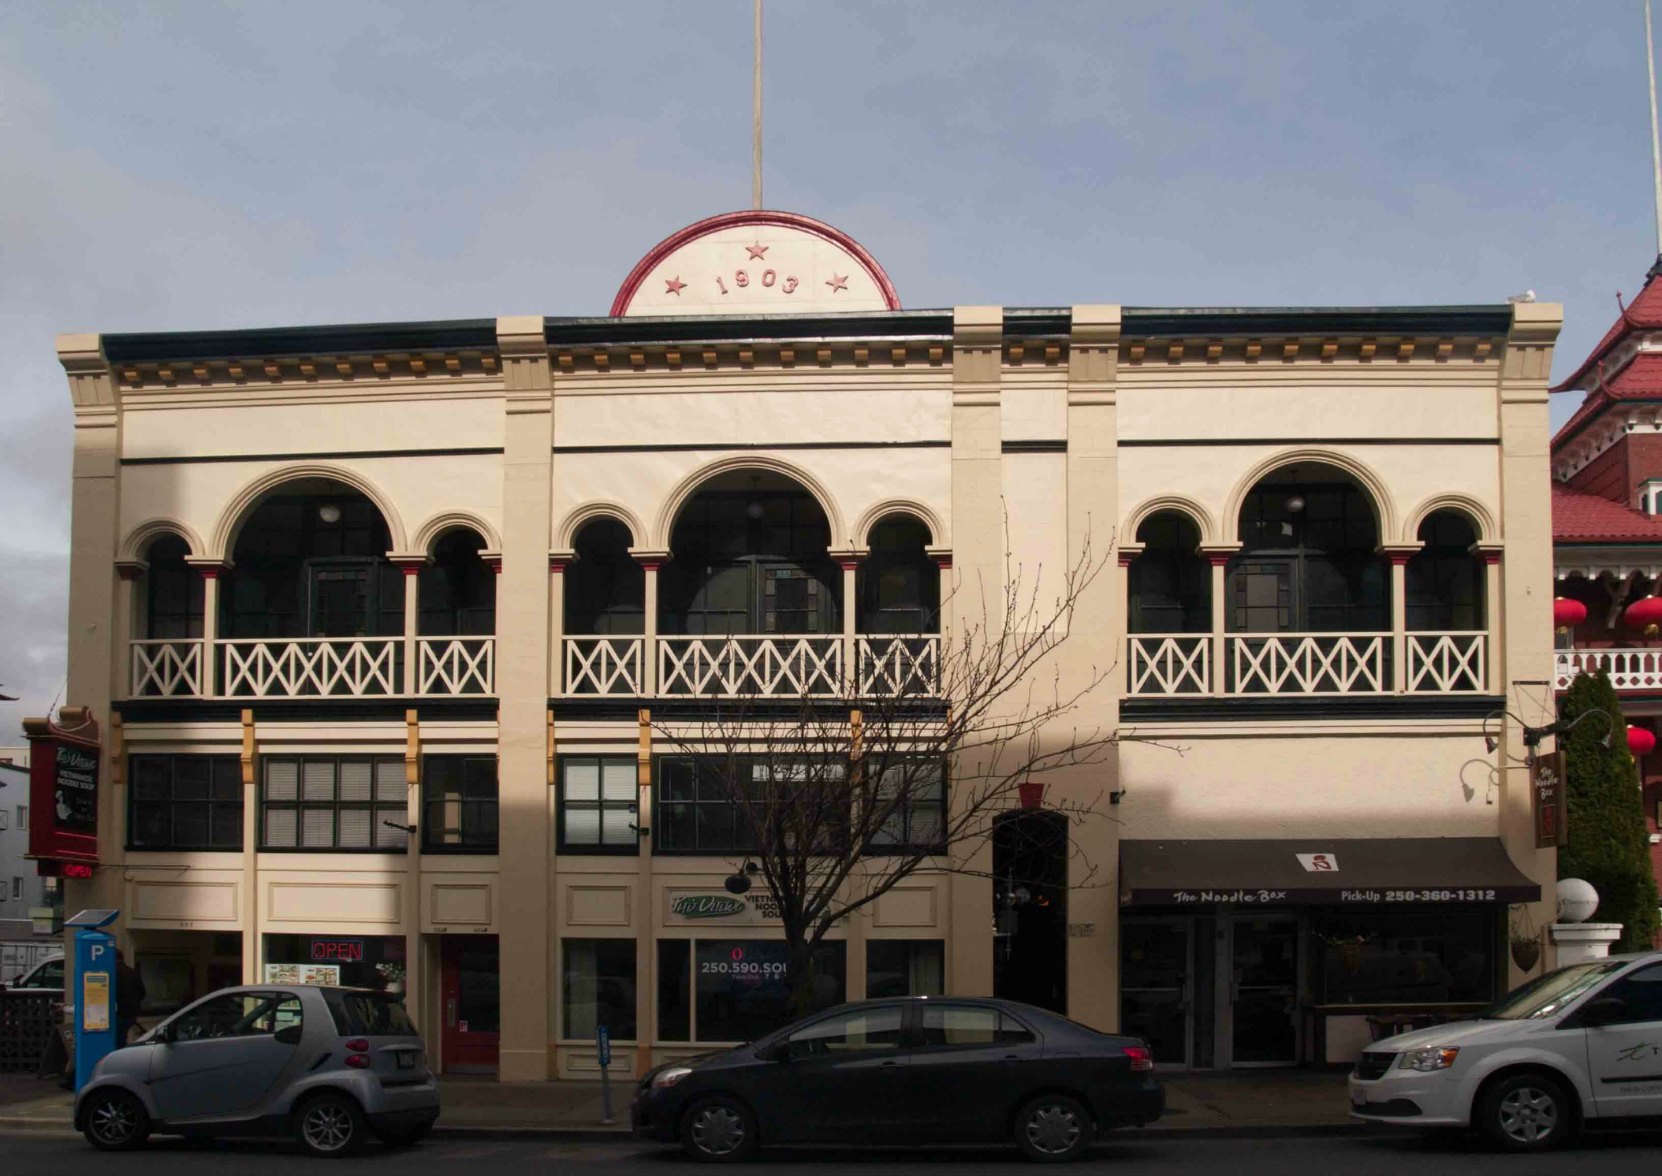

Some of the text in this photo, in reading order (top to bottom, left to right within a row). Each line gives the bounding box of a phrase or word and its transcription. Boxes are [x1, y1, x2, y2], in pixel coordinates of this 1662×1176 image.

[716, 269, 799, 295] 1903
[65, 864, 92, 878] OPEN
[1173, 890, 1286, 902] The Noodle Box
[1342, 890, 1496, 901] Pick-Up 250-360-1312
[761, 910, 782, 918] SOU
[91, 944, 104, 961] P
[313, 943, 361, 960] OPEN
